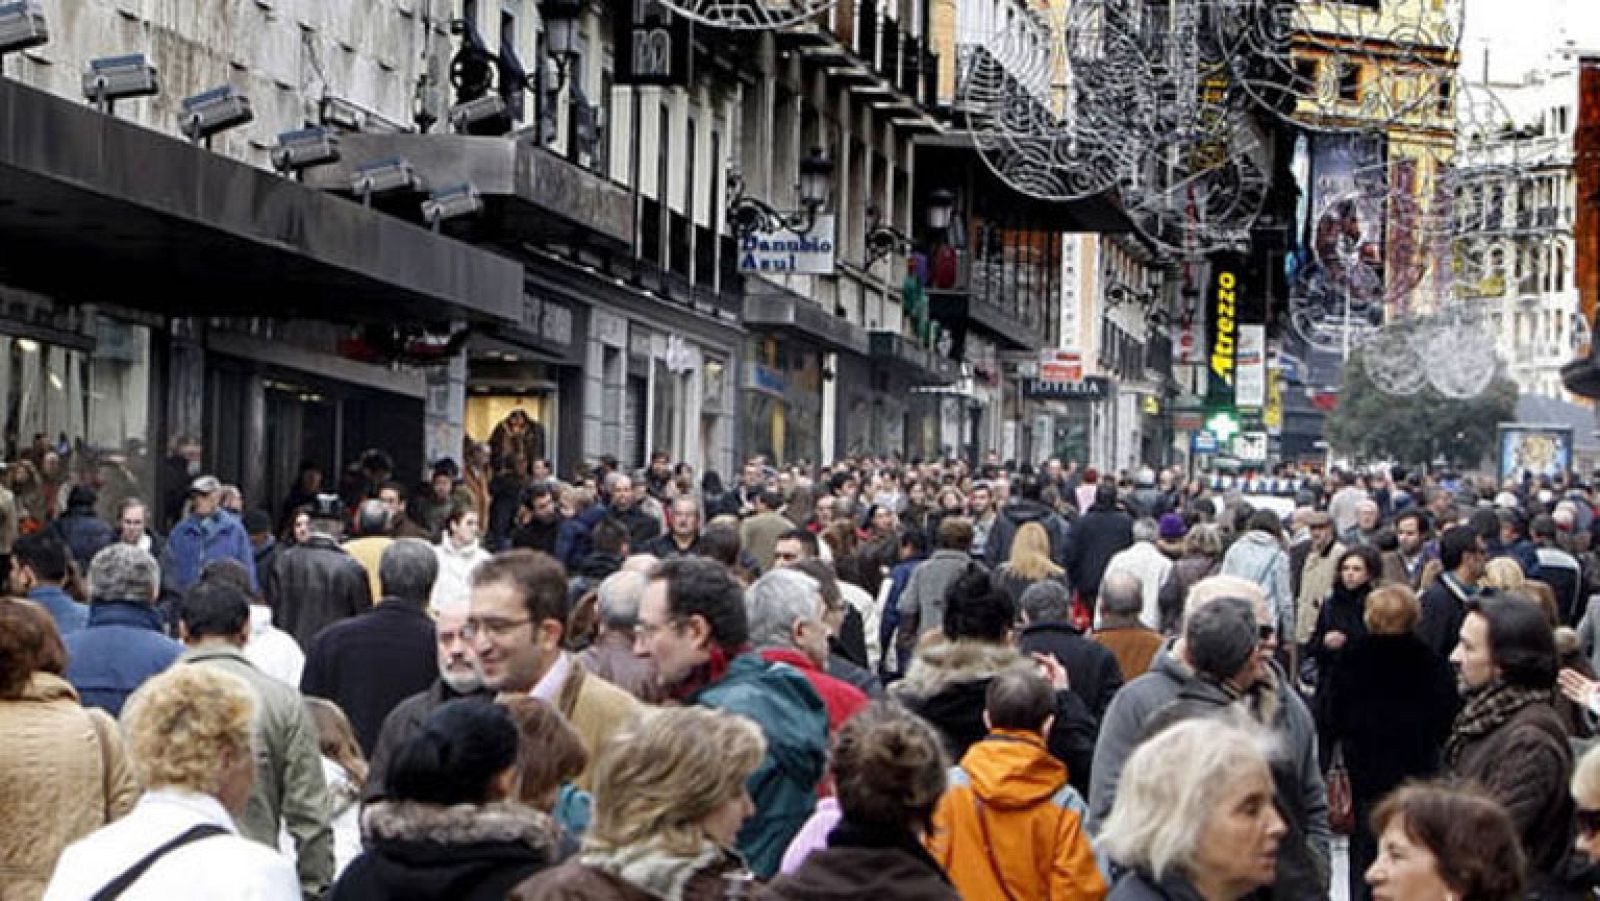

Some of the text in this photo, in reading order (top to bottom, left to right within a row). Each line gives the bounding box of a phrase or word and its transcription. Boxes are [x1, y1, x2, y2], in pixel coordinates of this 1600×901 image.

[742, 235, 833, 252] Danubio
[741, 254, 795, 269] Azul
[1210, 271, 1236, 386] Atrezzo
